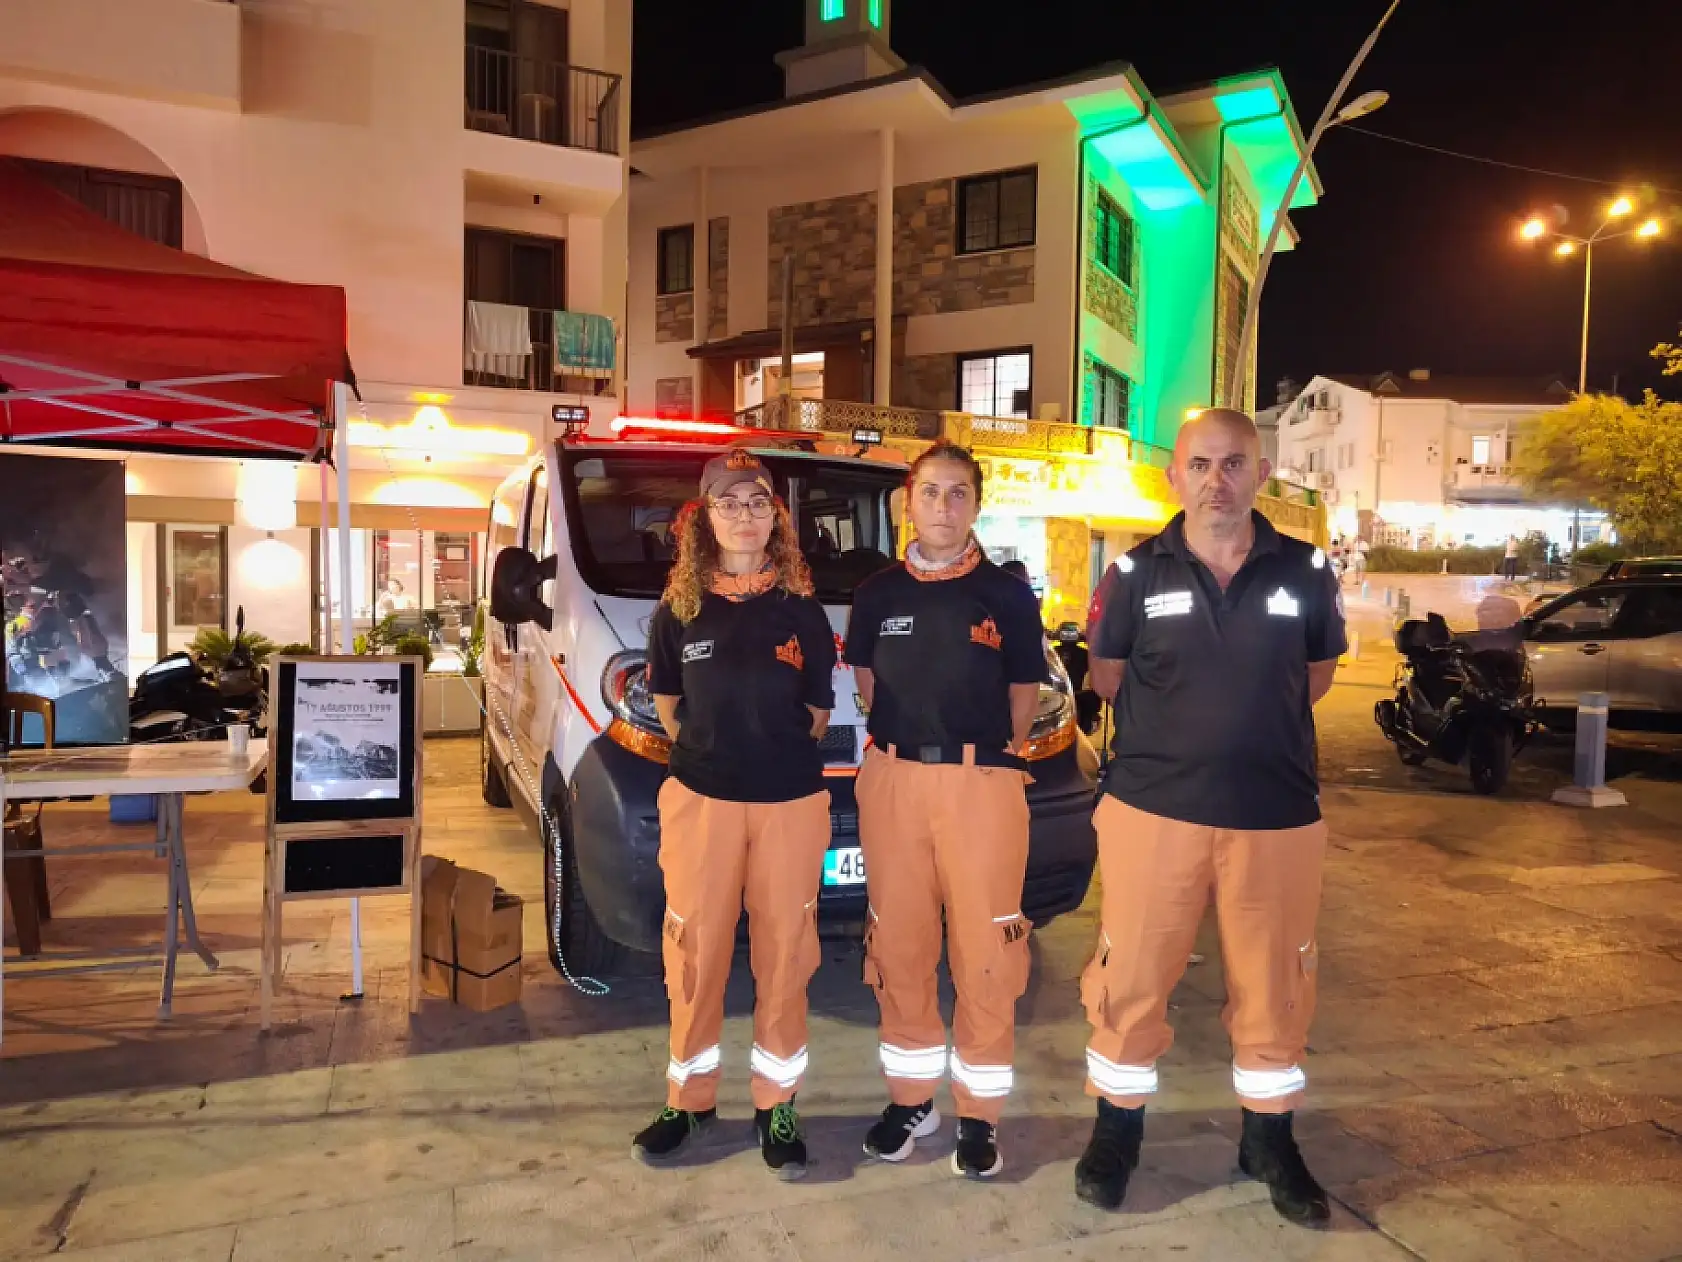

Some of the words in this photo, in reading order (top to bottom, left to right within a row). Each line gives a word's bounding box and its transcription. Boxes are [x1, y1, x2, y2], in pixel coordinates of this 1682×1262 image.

[306, 704, 317, 713] 17
[319, 703, 366, 713] AĞUSTOS
[368, 703, 393, 713] 1999
